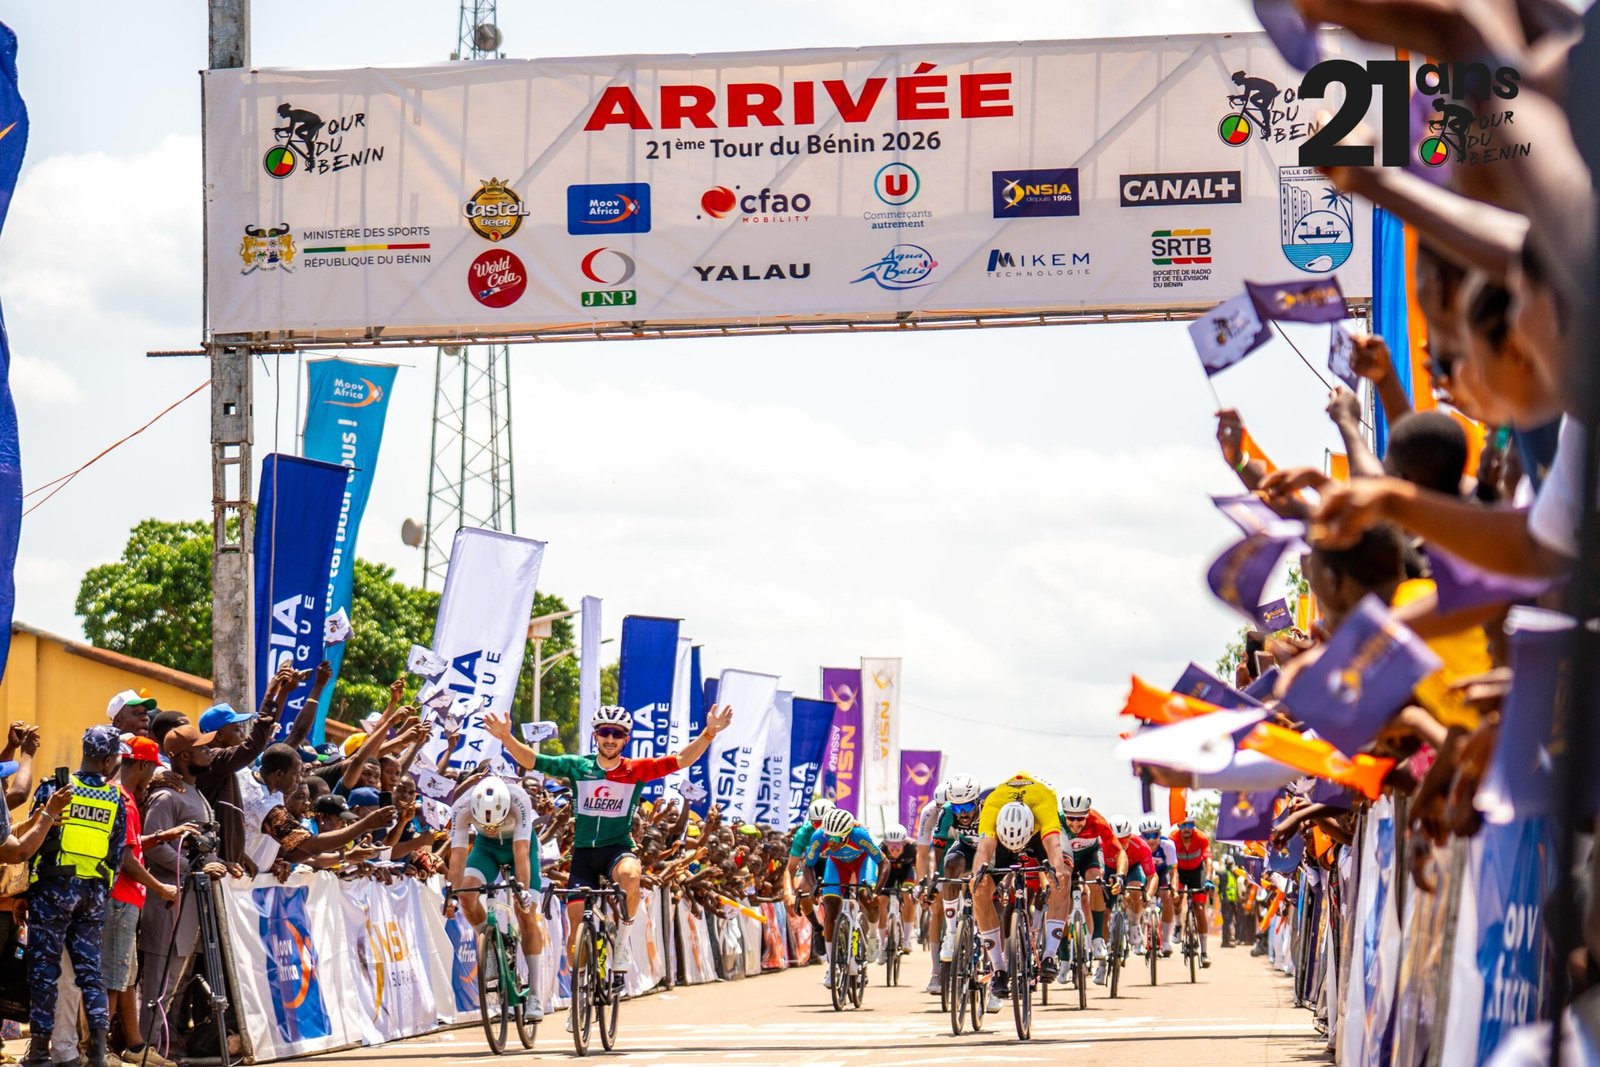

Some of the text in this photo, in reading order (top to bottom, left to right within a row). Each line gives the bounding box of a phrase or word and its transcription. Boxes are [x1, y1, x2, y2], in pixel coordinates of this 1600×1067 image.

[583, 62, 1014, 131] ARRIVÉE
[1271, 104, 1299, 125] DU
[1273, 120, 1320, 143] BEN
[315, 136, 343, 157] DU
[709, 138, 764, 158] Tour
[769, 135, 801, 157] du
[808, 132, 876, 155] Bénin
[881, 130, 942, 151] 2026
[317, 146, 385, 175] BENIN
[885, 174, 908, 197] U
[1025, 183, 1072, 196] NSIA
[1122, 176, 1236, 202] CANAL+
[589, 199, 620, 208] Moov
[740, 188, 811, 214] cfao
[1053, 194, 1073, 202] 1995
[589, 206, 620, 216] Africa
[742, 215, 811, 223] MOBILITY
[863, 210, 933, 221] Commerçants
[303, 226, 430, 241] MINISTÈRE DES SPORTS
[871, 220, 925, 230] autrement
[881, 248, 923, 262] Aqua
[1151, 238, 1212, 257] SRTB
[304, 253, 431, 268] RÉPUBLIQUE DU BÉNIN
[473, 255, 511, 277] World
[880, 260, 926, 280] Belle
[987, 249, 1090, 272] MIKEM
[487, 269, 520, 288] Cola
[693, 263, 811, 281] YALAU
[987, 269, 1091, 278] TECHNOLOGIE
[334, 378, 364, 391] Moov
[334, 387, 364, 400] Africa
[267, 594, 302, 683] SIA
[880, 701, 891, 760] NSIA
[836, 725, 856, 801] NSIA
[716, 746, 741, 821] NSIA
[732, 746, 752, 823] BANQUE
[755, 756, 771, 823] NSIA
[771, 756, 783, 825] BANQUE
[71, 804, 110, 823] POLICE
[583, 797, 624, 810] ALGERIA
